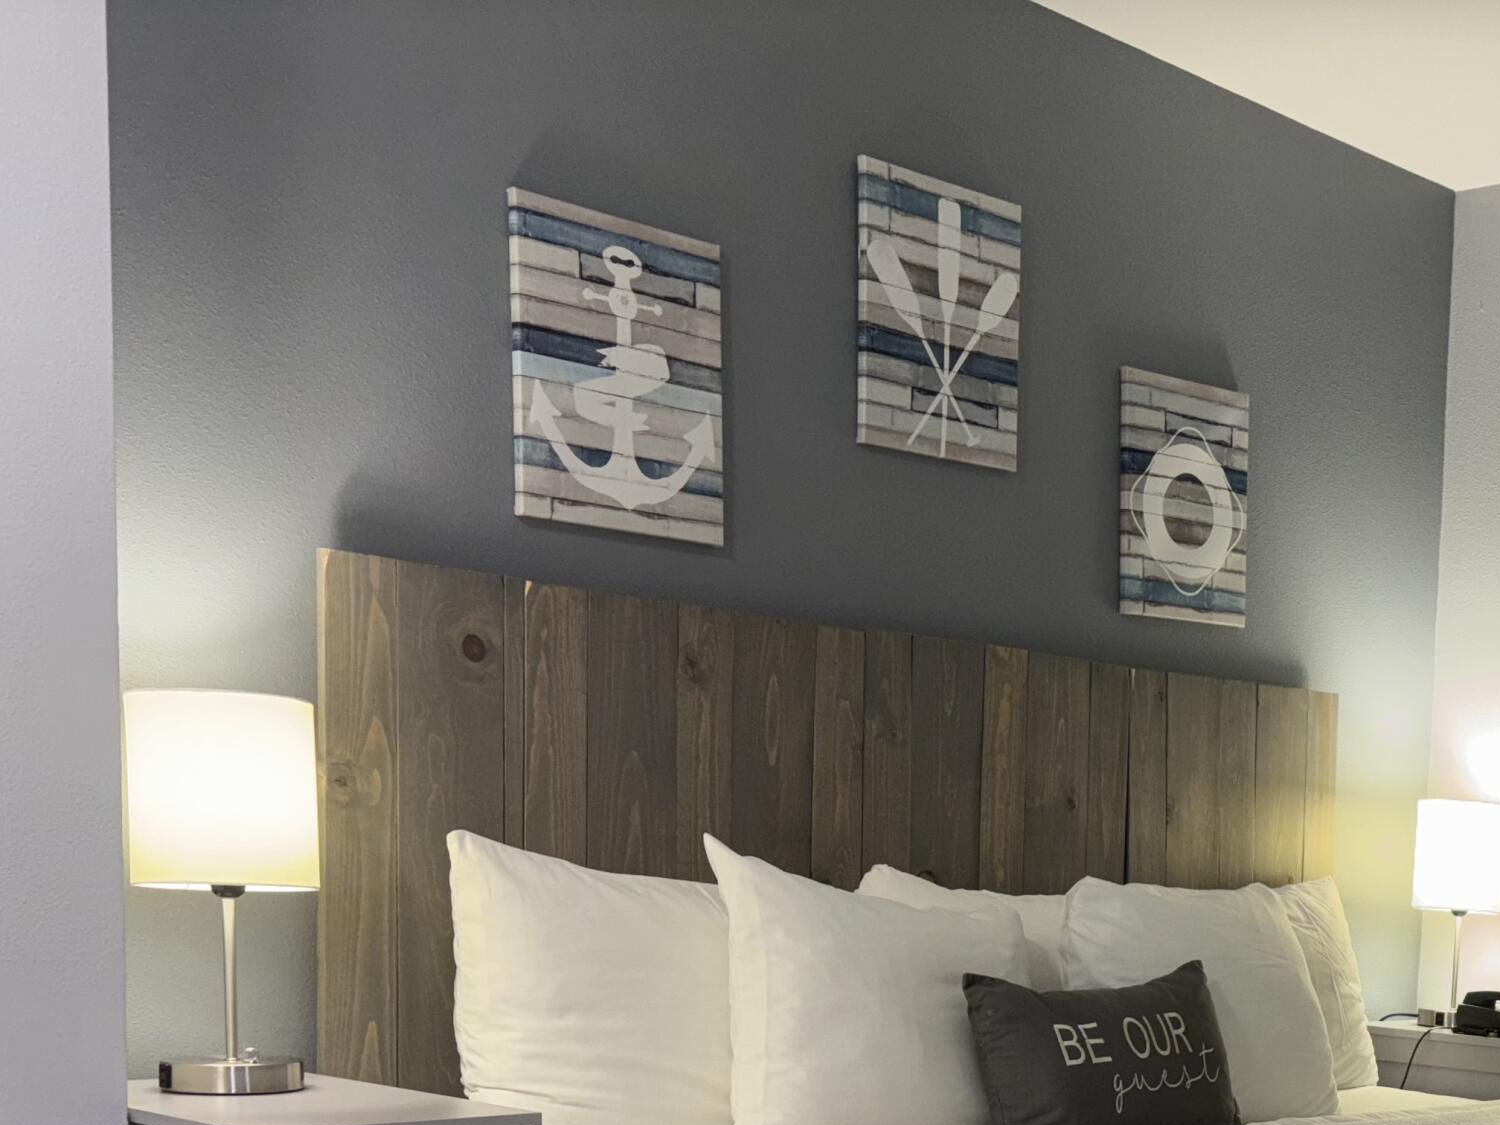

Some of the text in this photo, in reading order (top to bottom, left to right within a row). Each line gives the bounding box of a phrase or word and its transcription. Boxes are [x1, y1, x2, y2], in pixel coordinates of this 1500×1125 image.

[1053, 1012, 1193, 1066] BE OUR
[1113, 1043, 1220, 1114] guest
